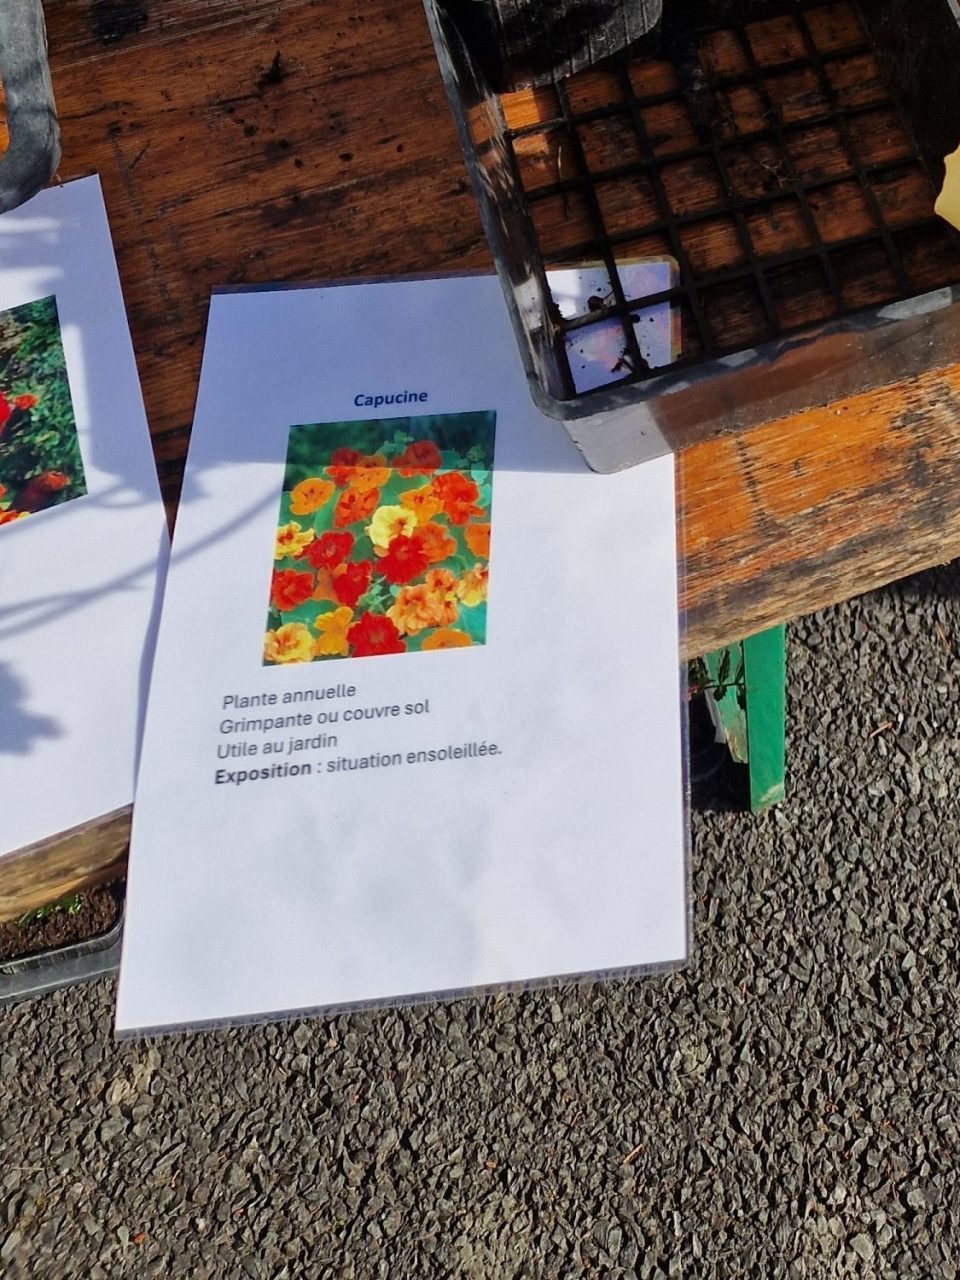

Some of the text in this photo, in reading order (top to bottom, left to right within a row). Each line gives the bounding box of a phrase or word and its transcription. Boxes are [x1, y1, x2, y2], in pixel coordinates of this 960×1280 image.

[353, 390, 428, 408] Capucine
[222, 684, 356, 710] Plante annuelle
[219, 699, 430, 734] Grimpante ou couvre sol
[216, 733, 338, 759] Utile au jardin
[214, 762, 312, 786] Exposition
[326, 752, 402, 773] situation
[406, 741, 503, 764] ensoleillée.
